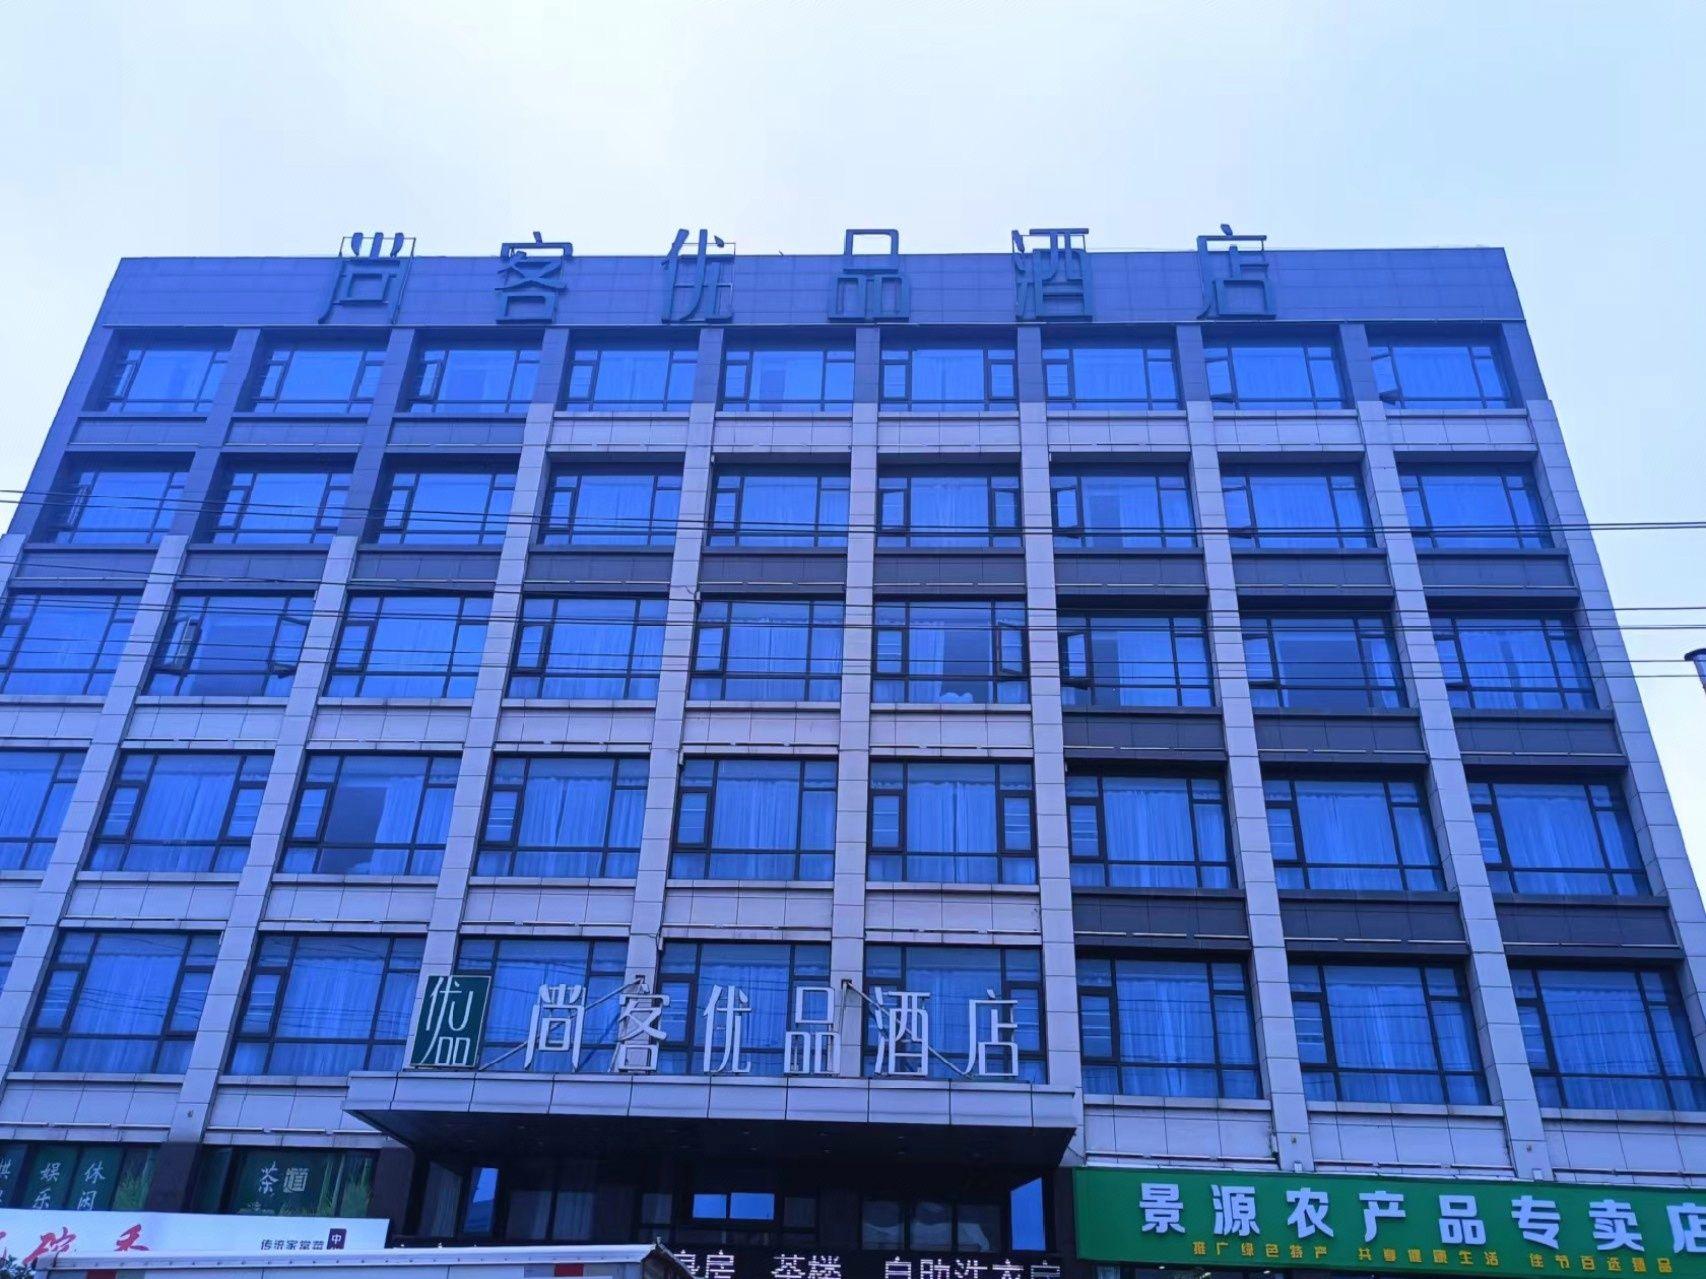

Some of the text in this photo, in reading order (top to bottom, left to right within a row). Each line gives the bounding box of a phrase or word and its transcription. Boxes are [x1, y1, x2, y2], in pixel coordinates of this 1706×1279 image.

[318, 224, 1277, 324] 尚客优品酒店
[524, 982, 1020, 1078] 尚客优品酒店
[77, 1161, 106, 1210] 休闲
[1139, 1182, 1706, 1254] 景源农产品专卖店
